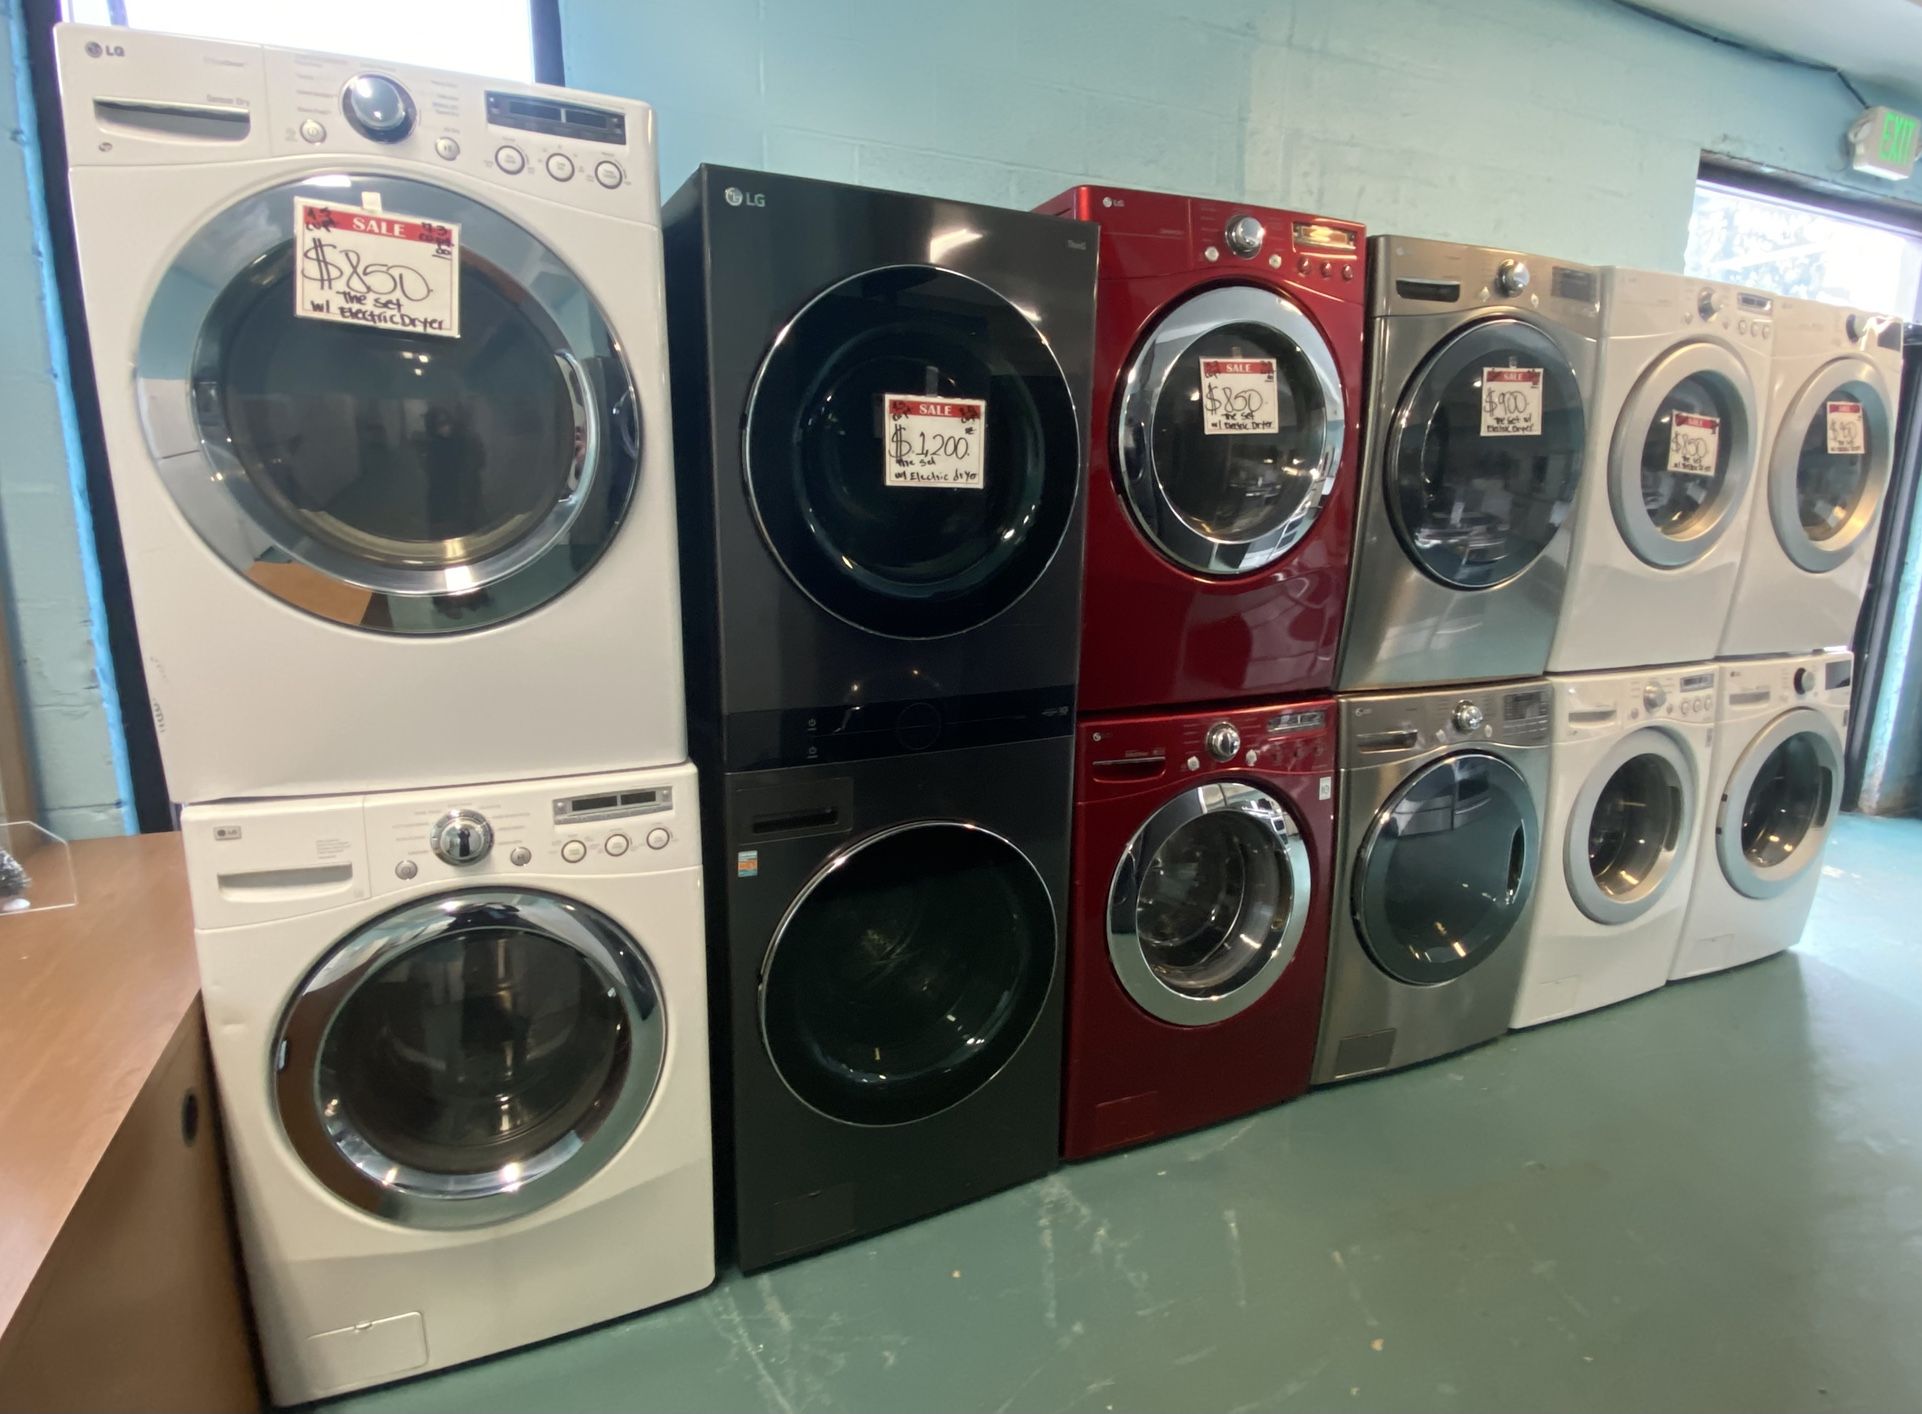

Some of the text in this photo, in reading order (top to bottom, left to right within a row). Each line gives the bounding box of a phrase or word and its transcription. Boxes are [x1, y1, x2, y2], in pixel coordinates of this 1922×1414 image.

[746, 191, 766, 207] LG
[352, 217, 406, 238] SALE
[373, 297, 404, 312] set
[338, 306, 400, 325] Electric
[401, 313, 445, 332] Dryer
[1226, 364, 1251, 372] SALE
[919, 404, 953, 416] SALE
